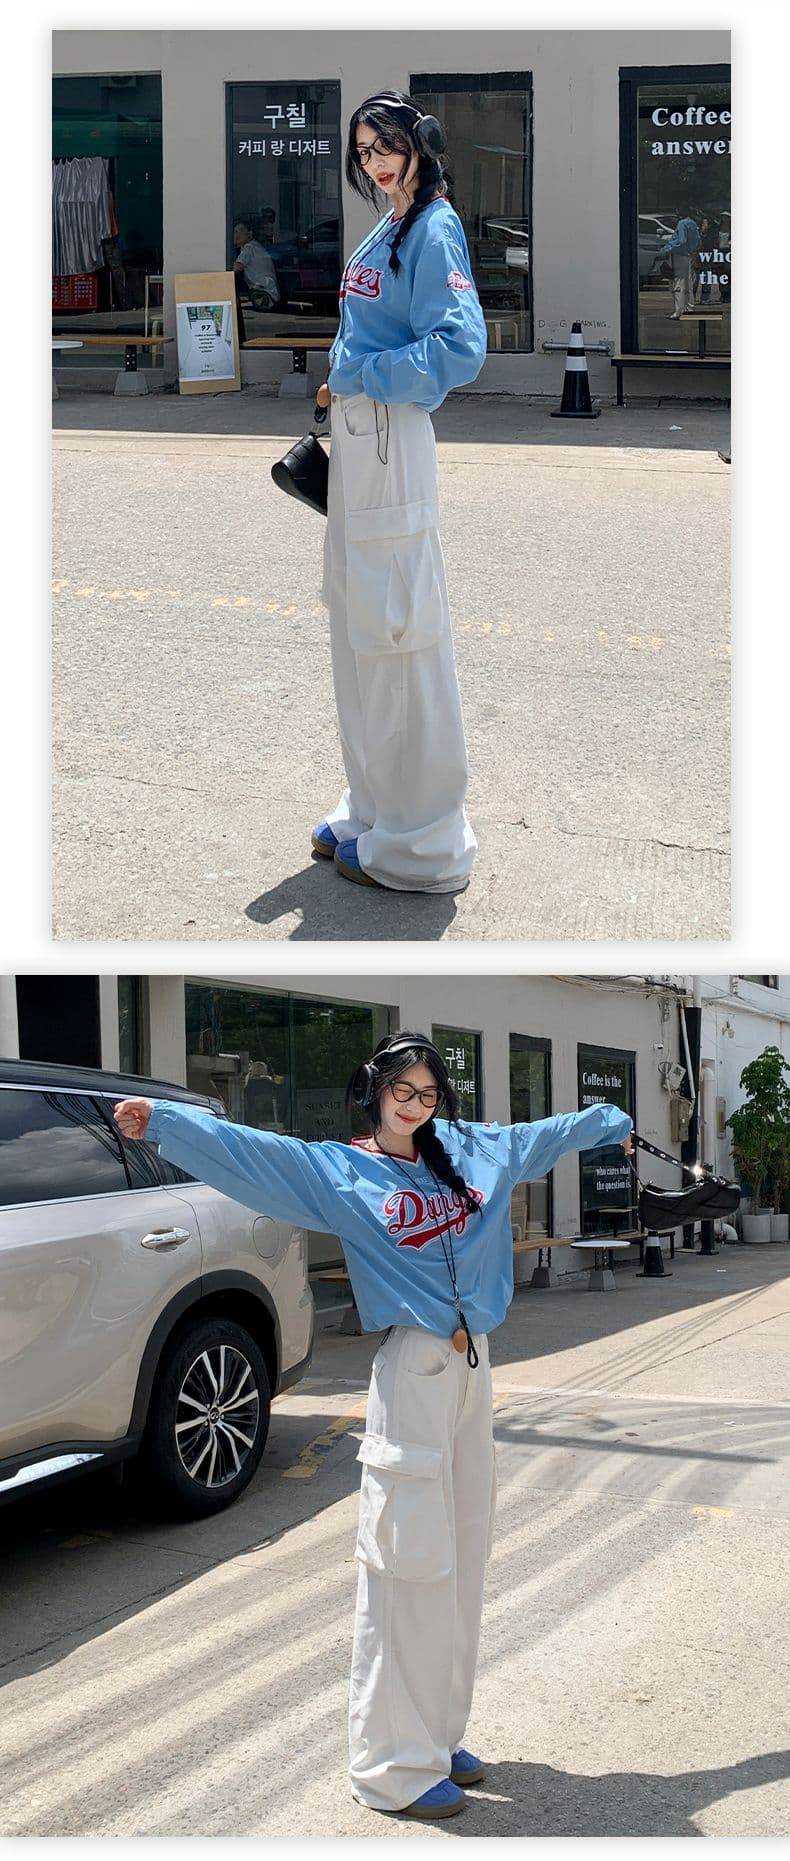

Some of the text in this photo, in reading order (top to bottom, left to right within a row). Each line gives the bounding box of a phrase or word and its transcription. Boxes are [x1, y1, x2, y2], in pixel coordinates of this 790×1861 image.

[263, 103, 306, 129] 구칠
[651, 106, 731, 126] Coffee
[238, 140, 331, 156] 커피 랑 디저트
[699, 271, 729, 285] the
[201, 324, 212, 332] 97
[445, 1047, 465, 1070] 구칠
[457, 1080, 476, 1095] 디저트
[582, 1072, 622, 1088] Coffee is the
[582, 1094, 606, 1105] answer
[596, 1165, 606, 1176] who
[606, 1167, 619, 1176] cares
[596, 1180, 605, 1191] the
[605, 1179, 625, 1192] question
